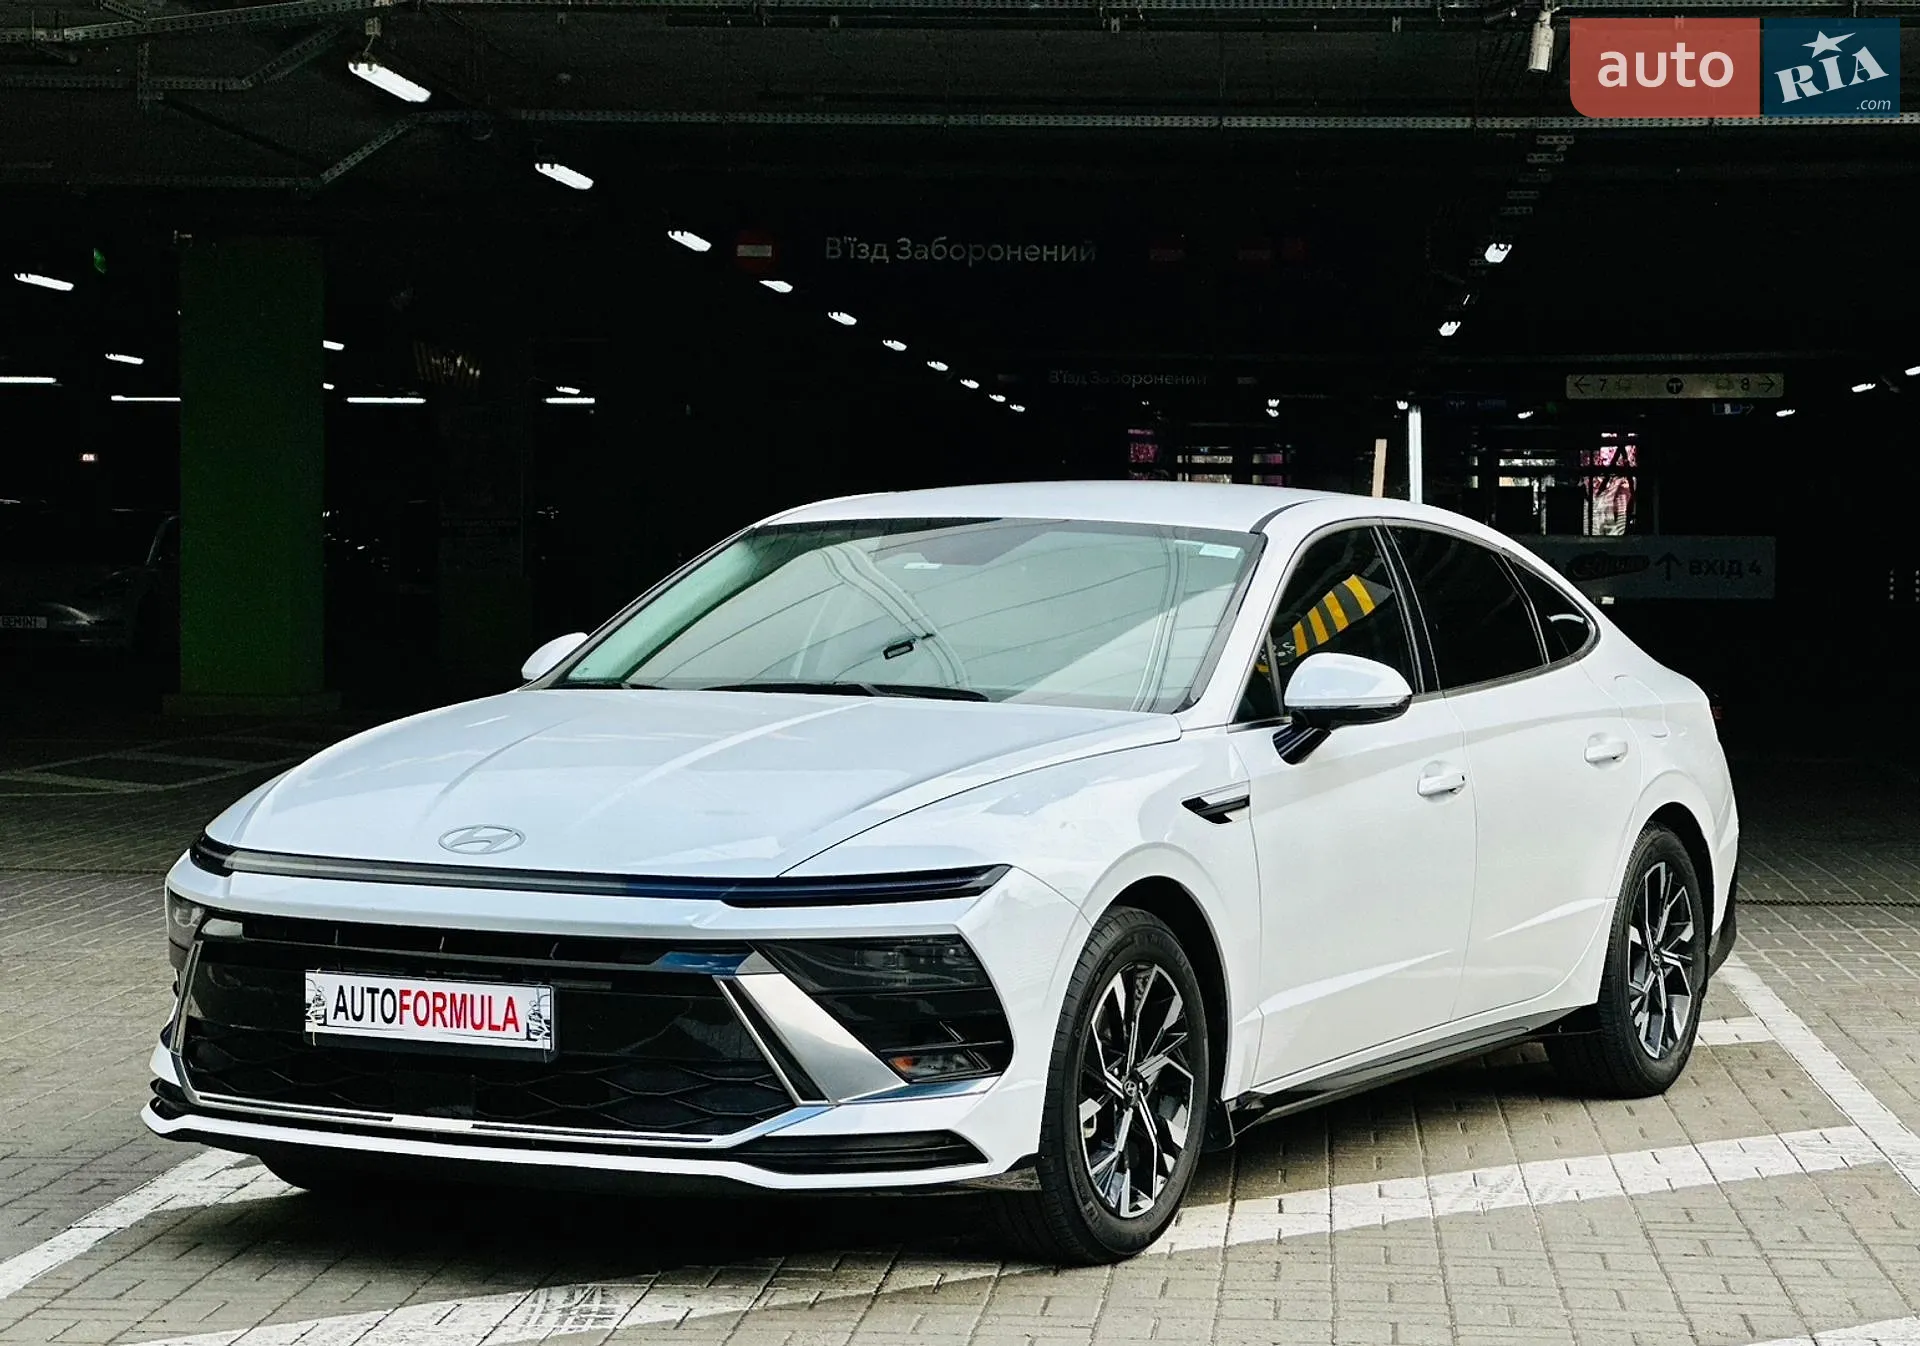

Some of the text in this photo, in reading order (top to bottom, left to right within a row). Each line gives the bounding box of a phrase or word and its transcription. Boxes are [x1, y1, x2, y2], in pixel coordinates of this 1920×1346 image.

[825, 236, 1096, 267] В'їзд Заборонений
[1599, 378, 1607, 391] 7
[1741, 378, 1750, 391] 8
[1749, 560, 1763, 575] 4
[333, 985, 520, 1033] AUTOFORMULA
